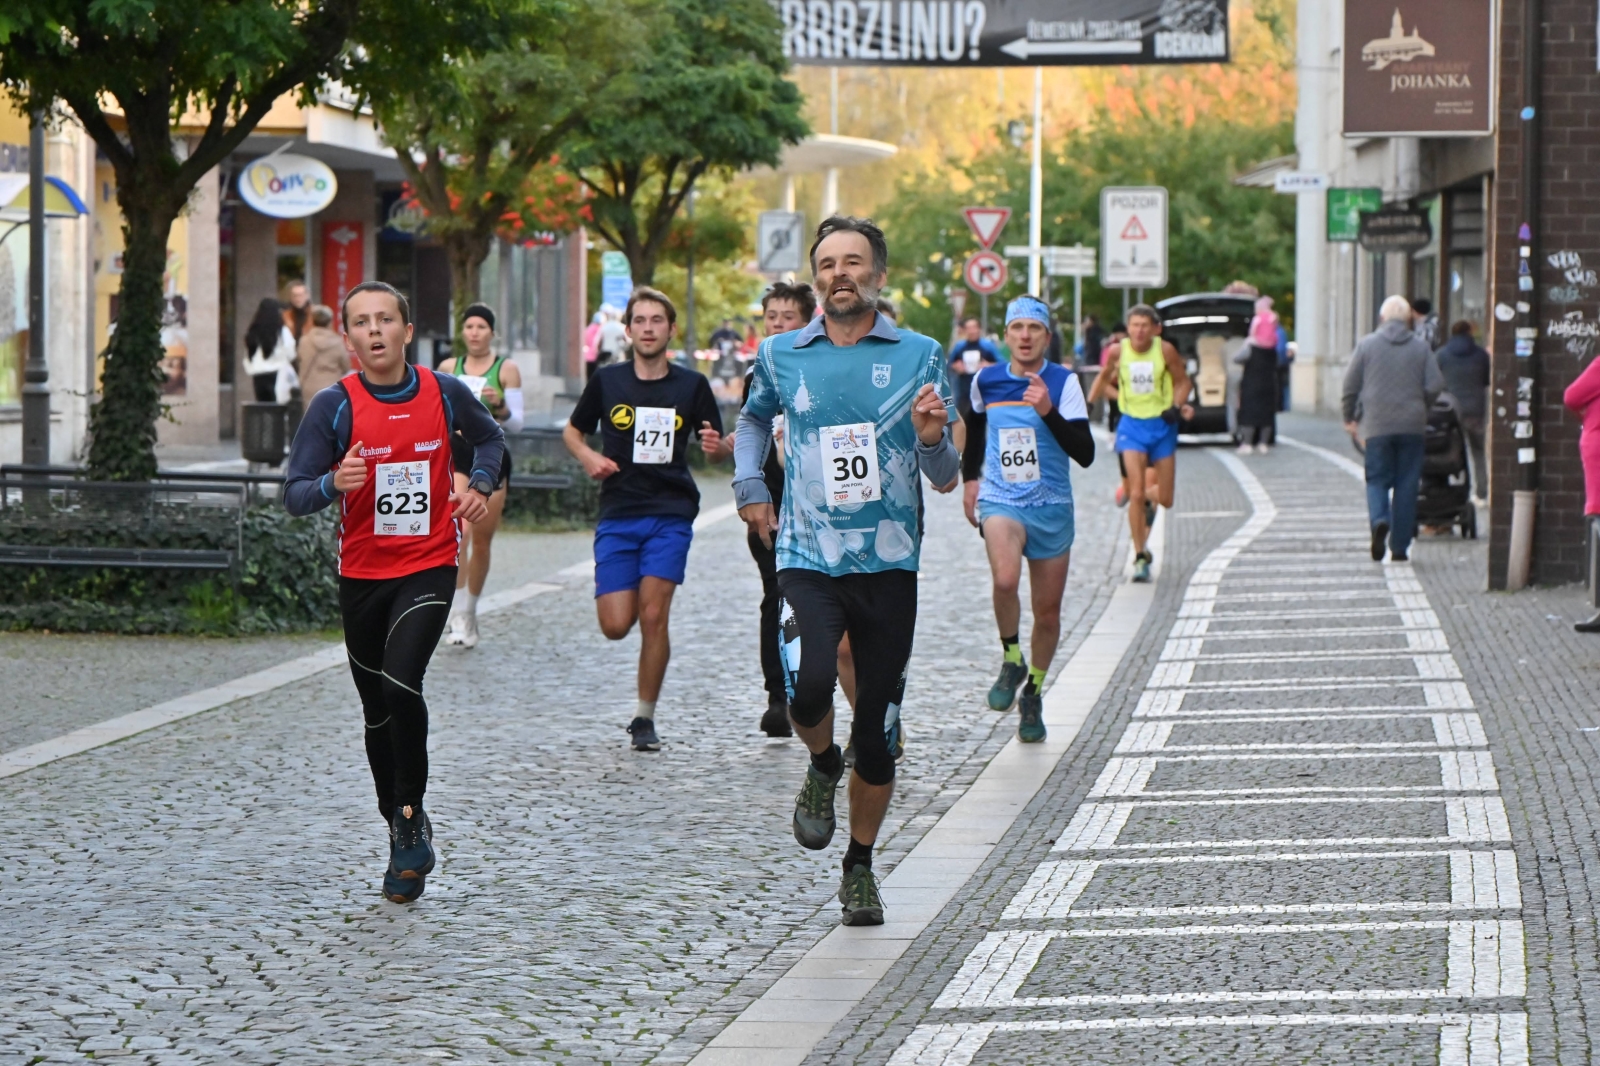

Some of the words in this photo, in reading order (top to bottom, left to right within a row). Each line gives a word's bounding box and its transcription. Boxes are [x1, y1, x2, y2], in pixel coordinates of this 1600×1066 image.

[773, 0, 987, 61] RRRZLINU?
[1391, 74, 1472, 92] JOHANKA
[1110, 195, 1159, 209] POZOR
[635, 430, 670, 447] 471
[1001, 450, 1037, 467] 664
[833, 455, 868, 481] 30
[377, 492, 428, 515] 623
